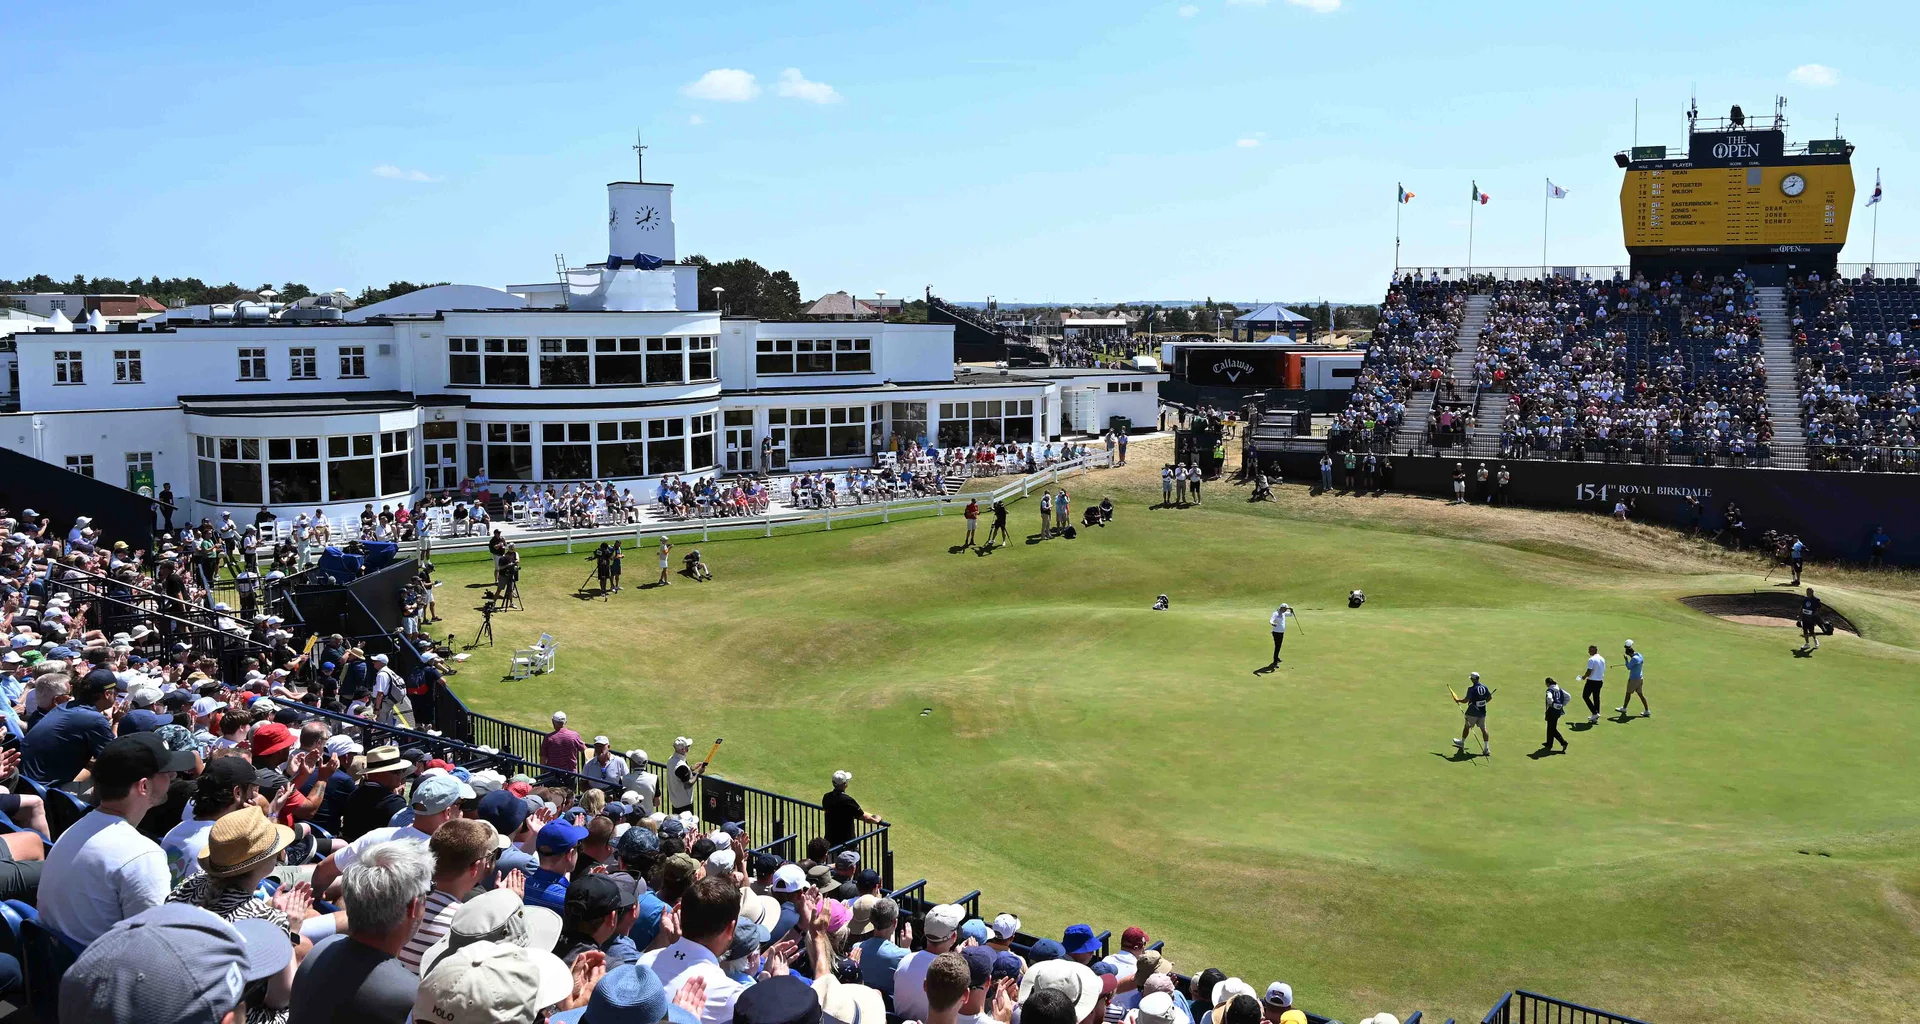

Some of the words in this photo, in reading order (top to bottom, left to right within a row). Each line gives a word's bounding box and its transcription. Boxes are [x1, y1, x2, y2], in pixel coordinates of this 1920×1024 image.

[1727, 136, 1746, 144] THE
[1713, 143, 1760, 158] OPEN
[1213, 359, 1254, 374] Callaway
[1619, 485, 1654, 494] ROYAL
[1657, 486, 1712, 497] BIRKDALE
[432, 1005, 454, 1021] POLO
